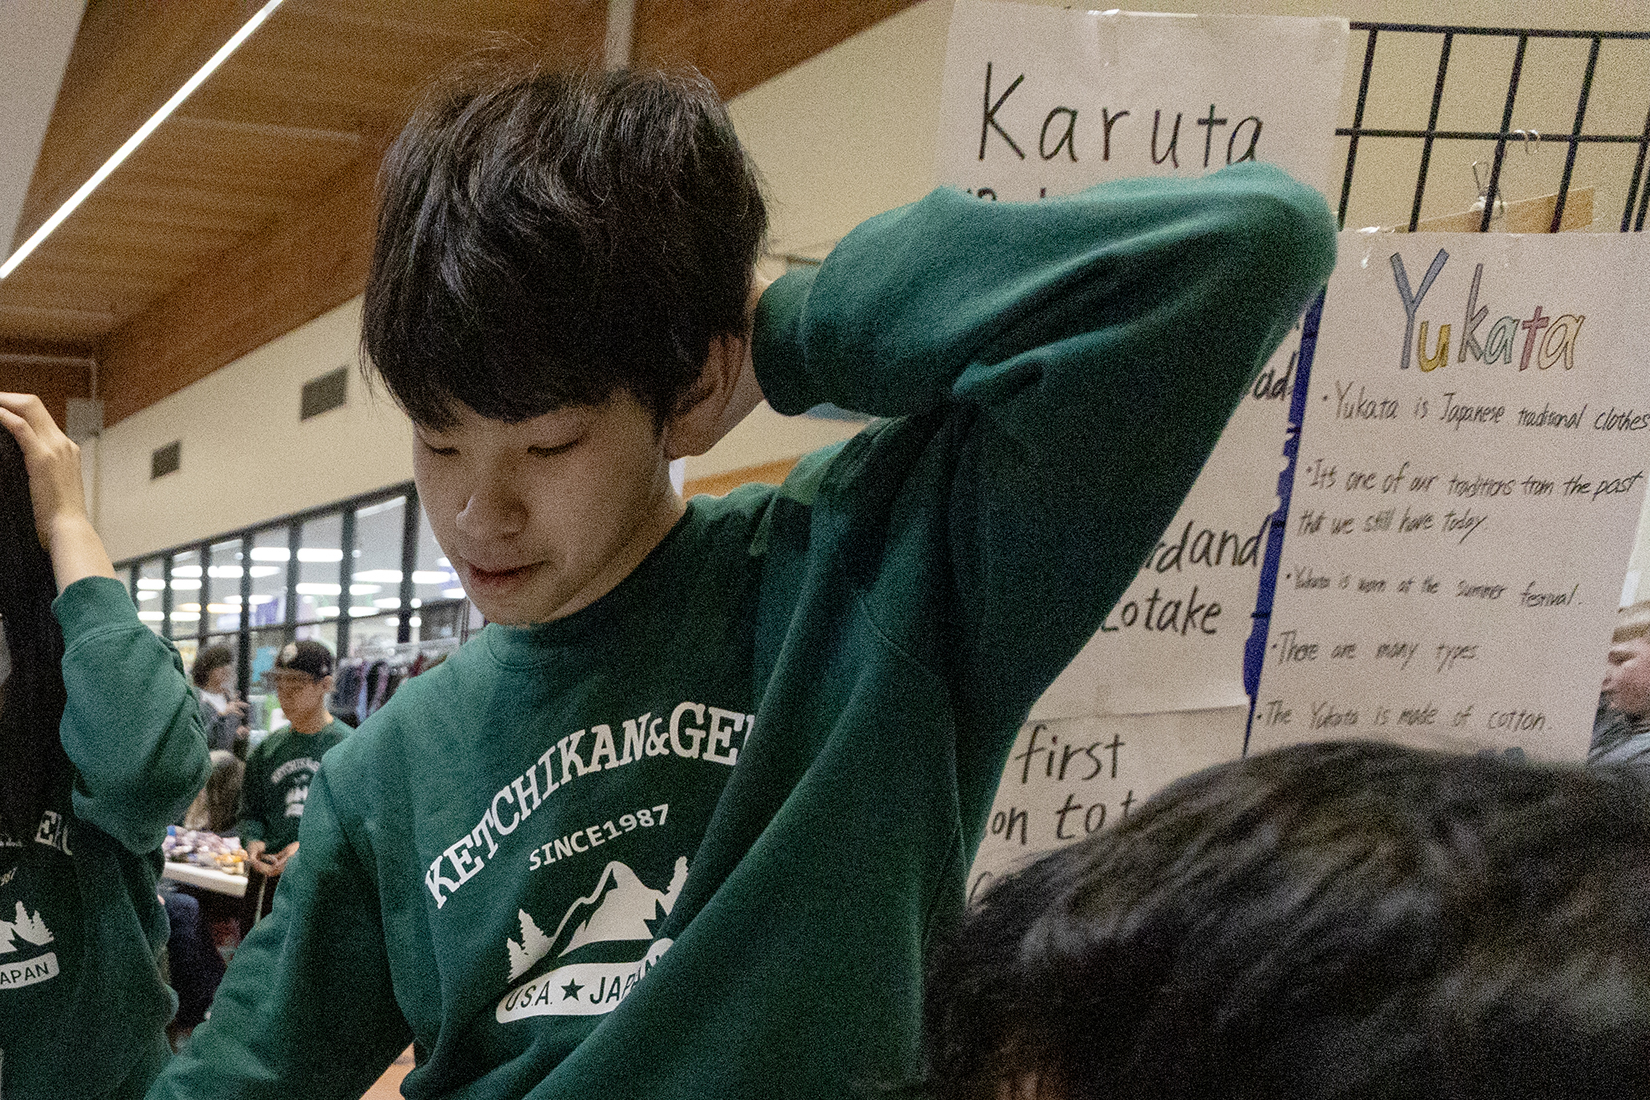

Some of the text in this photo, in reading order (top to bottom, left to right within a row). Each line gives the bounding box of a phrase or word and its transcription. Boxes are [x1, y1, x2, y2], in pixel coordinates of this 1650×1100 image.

[977, 61, 1265, 168] Karuta
[1390, 248, 1583, 372] Yukata
[1334, 381, 1399, 421] Yukata
[1414, 398, 1429, 420] is
[1441, 391, 1505, 431] Japanese
[1382, 462, 1410, 494] of
[1563, 473, 1591, 496] the
[1590, 470, 1644, 501] past
[1015, 725, 1125, 784] first
[425, 701, 755, 909] KETCHIKAN&GE
